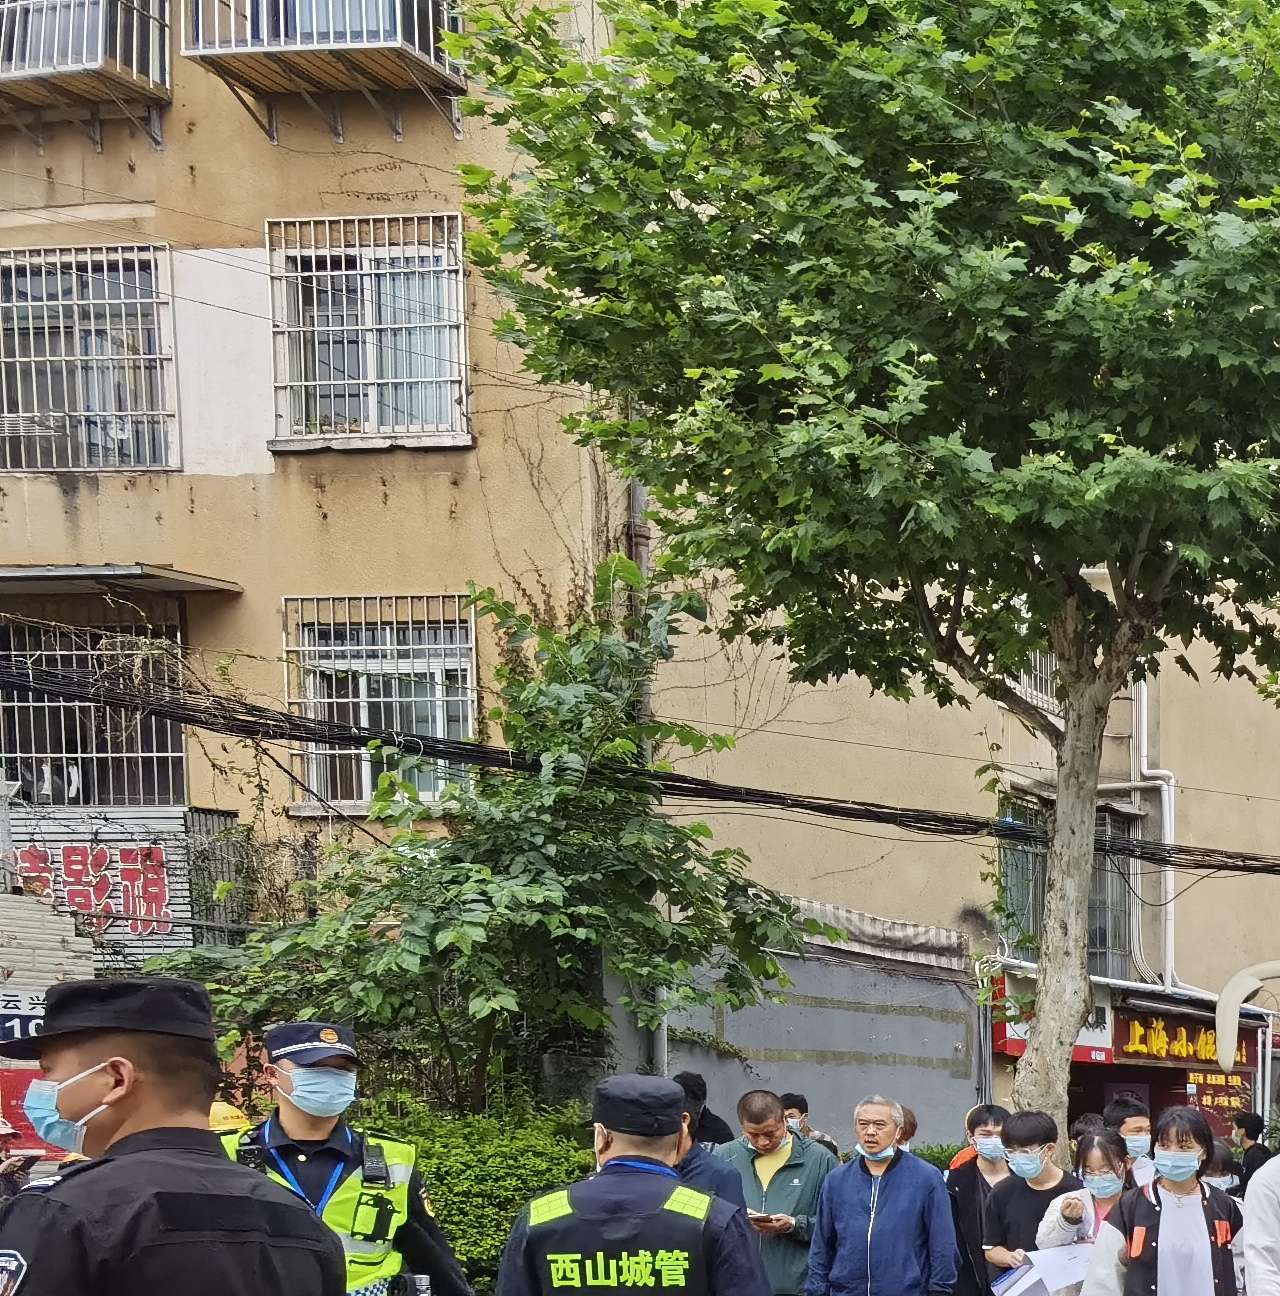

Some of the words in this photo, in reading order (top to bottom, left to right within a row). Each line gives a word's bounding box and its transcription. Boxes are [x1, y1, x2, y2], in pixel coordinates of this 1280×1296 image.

[1123, 1017, 1241, 1062] 上海小馄
[547, 1250, 689, 1287] 西山城管
